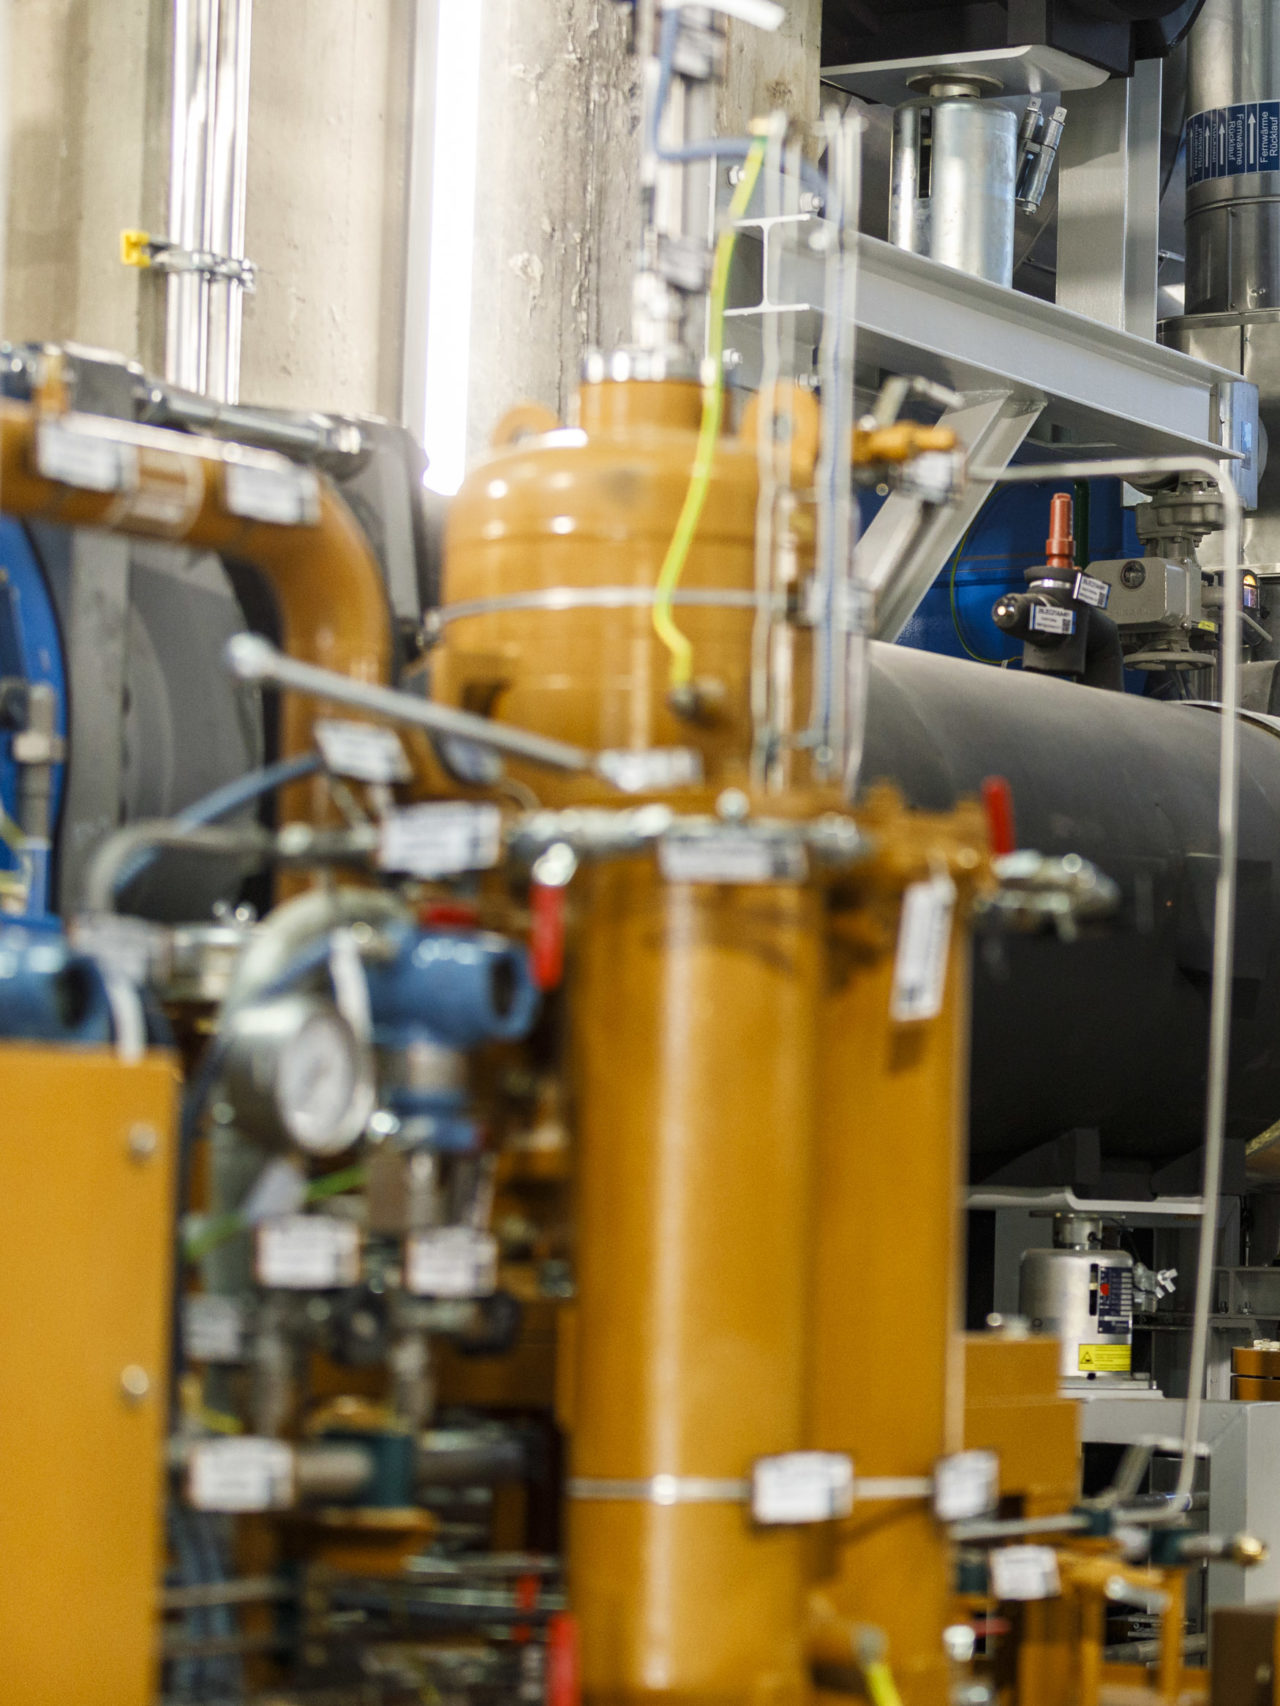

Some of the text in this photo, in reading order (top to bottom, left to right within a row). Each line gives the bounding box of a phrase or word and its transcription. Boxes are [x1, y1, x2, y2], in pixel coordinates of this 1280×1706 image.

[1228, 120, 1236, 161] Rücklauf
[1236, 113, 1244, 165] Fernwärme
[1260, 111, 1269, 163] Fernwärme
[1269, 116, 1278, 157] Rücklauf
